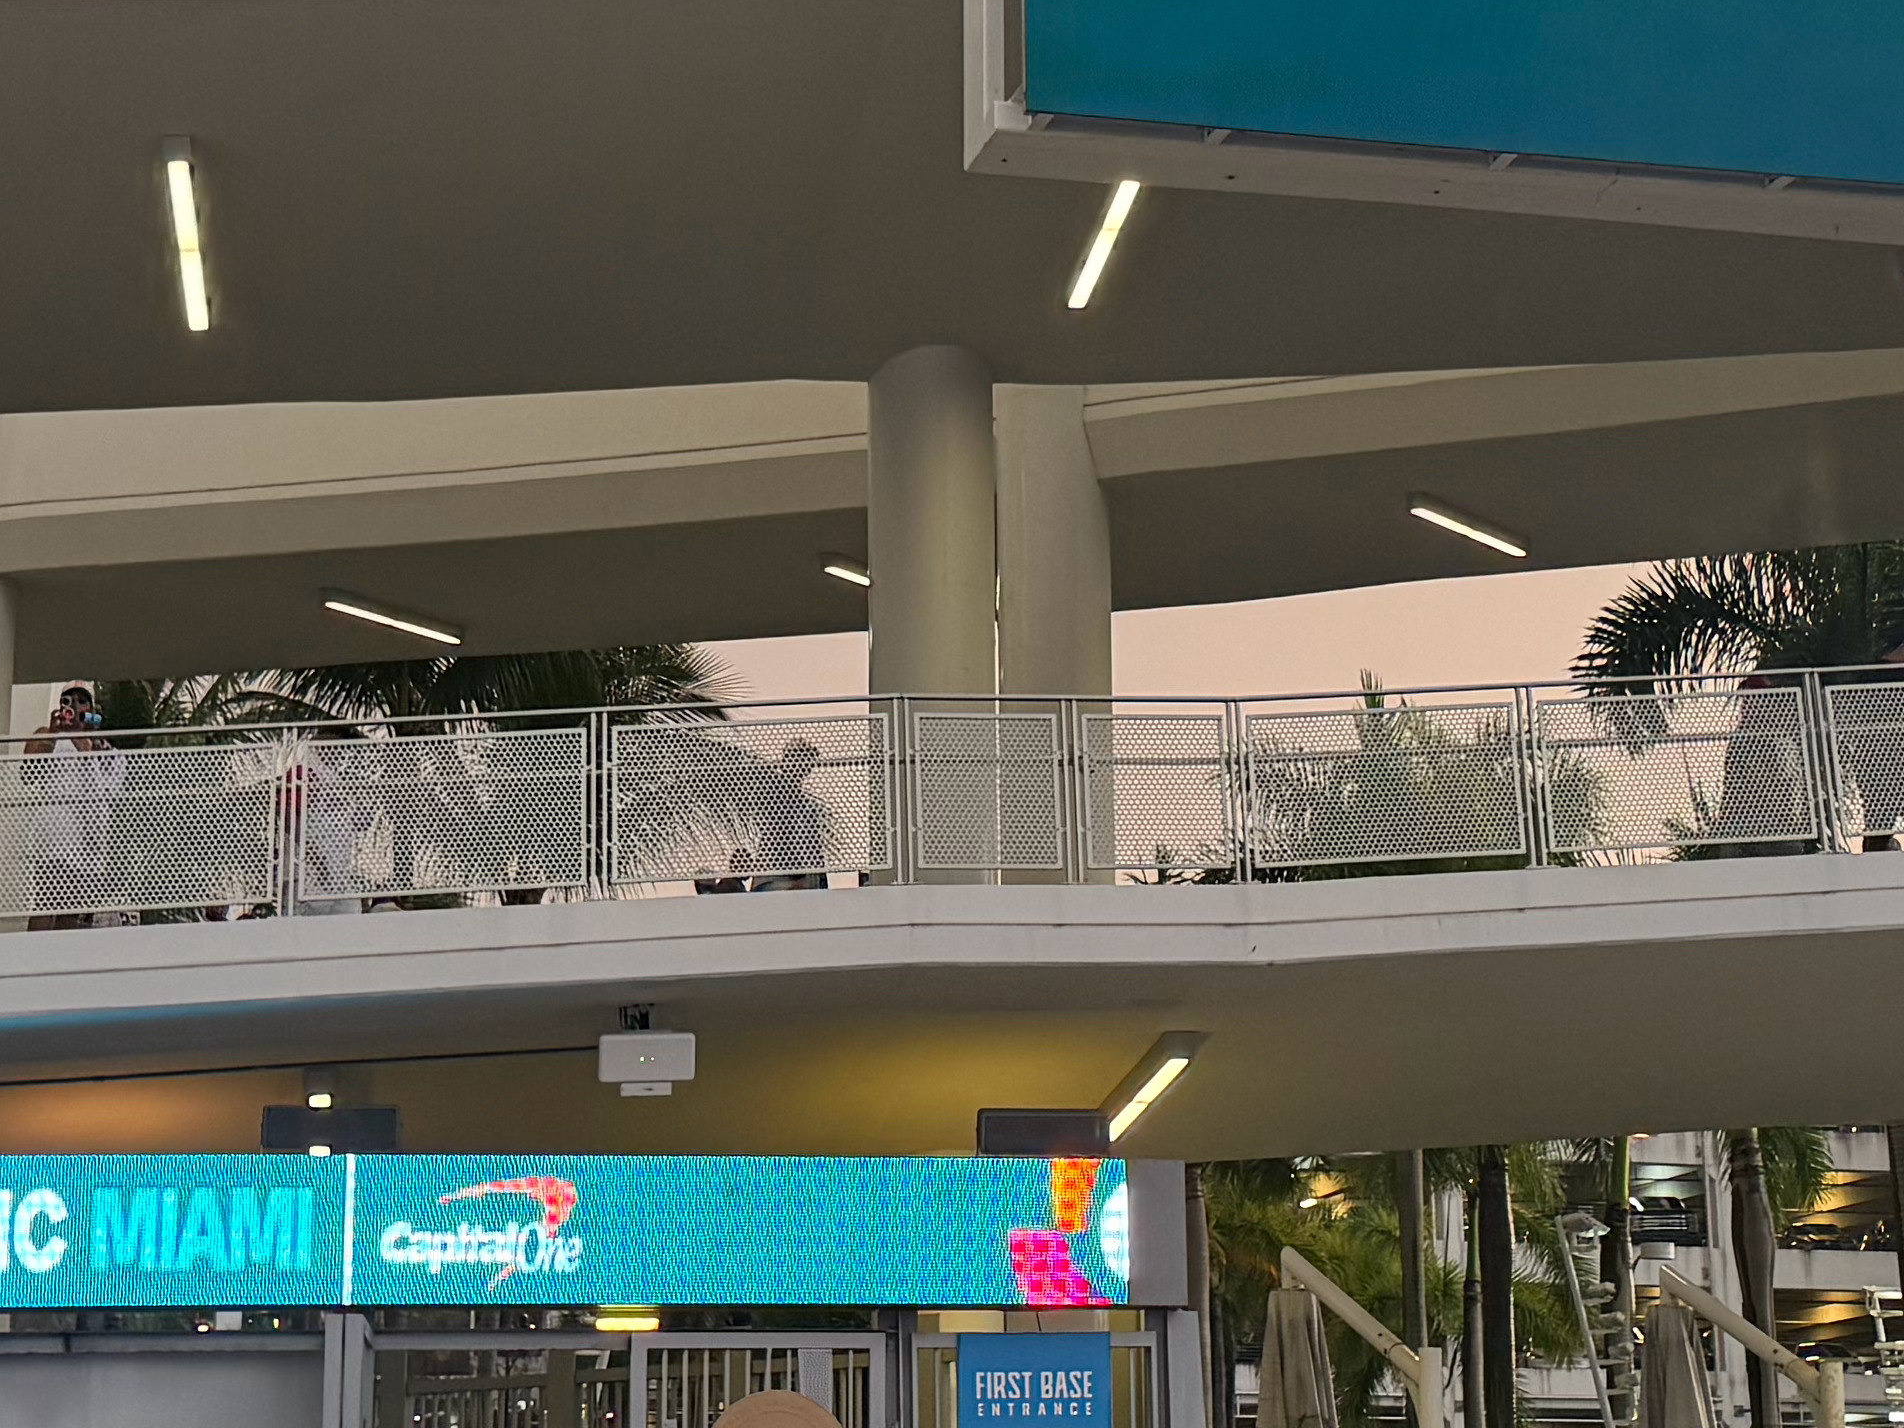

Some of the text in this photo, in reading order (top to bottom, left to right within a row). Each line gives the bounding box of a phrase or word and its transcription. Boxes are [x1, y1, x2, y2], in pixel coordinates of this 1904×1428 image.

[96, 1186, 314, 1272] MIAMI
[975, 1371, 1094, 1400] FIRST BASE
[977, 1402, 1093, 1417] ENTRANCE
